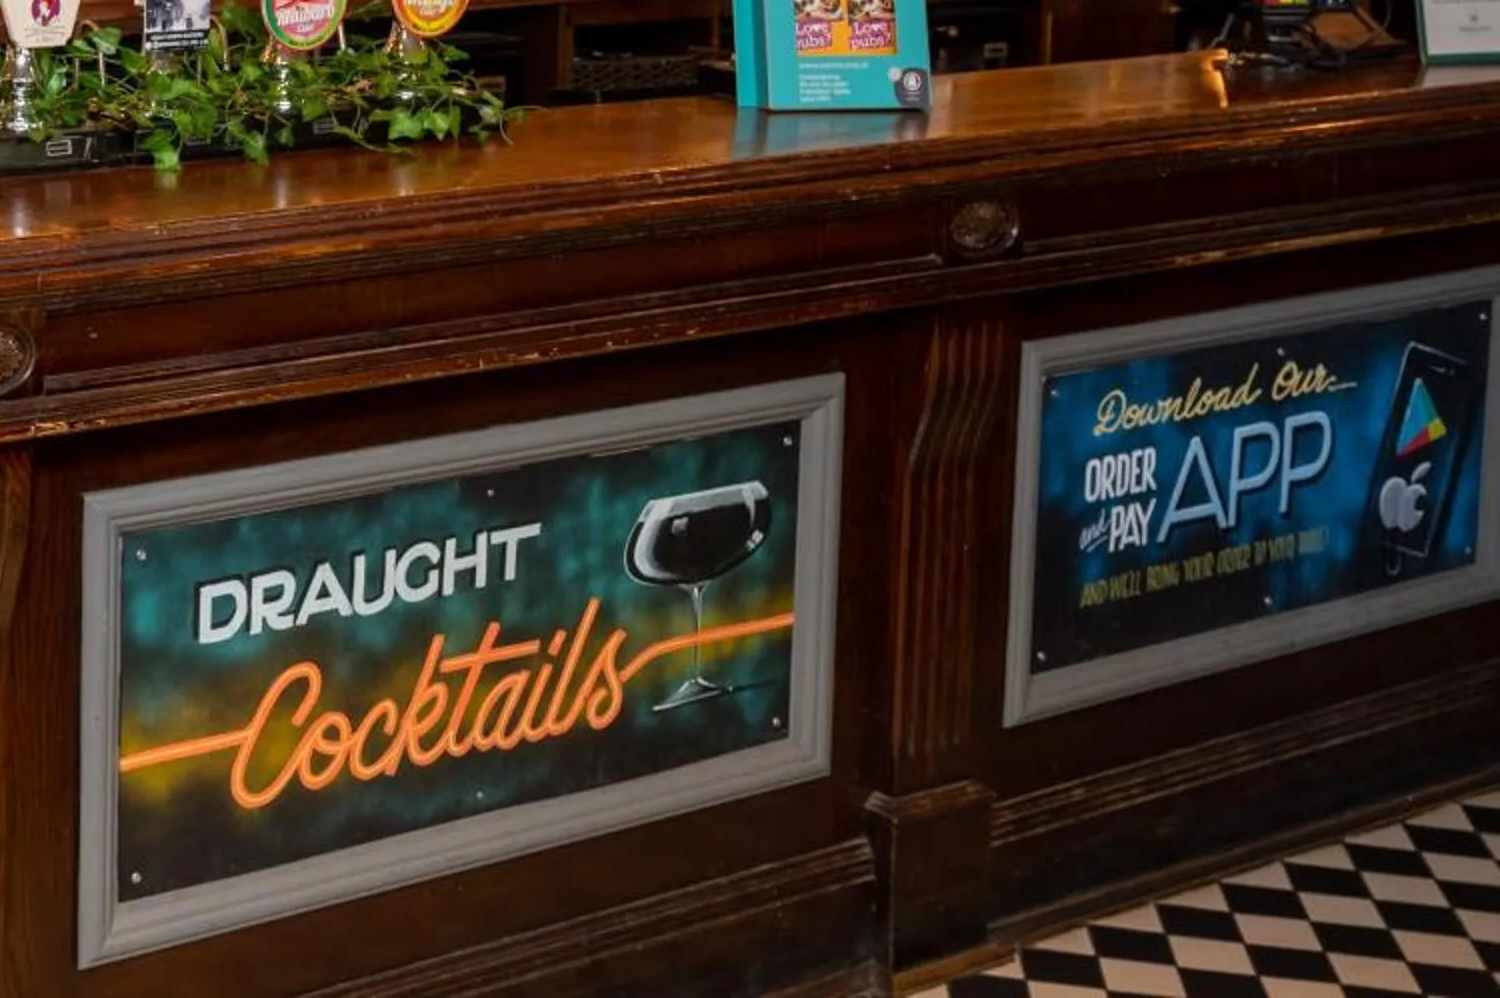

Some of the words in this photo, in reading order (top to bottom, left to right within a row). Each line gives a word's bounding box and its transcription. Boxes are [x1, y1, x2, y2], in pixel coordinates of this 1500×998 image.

[1093, 362, 1262, 437] Download
[1084, 446, 1158, 502] ORDER
[1156, 410, 1333, 544] APP
[1079, 511, 1109, 551] and
[1108, 498, 1157, 553] PAY
[198, 522, 542, 645] DRAUGHT
[1079, 579, 1108, 609] AND
[1182, 551, 1215, 582] YOUR
[1216, 543, 1252, 574] ORDER
[229, 598, 628, 810] Cocktails
